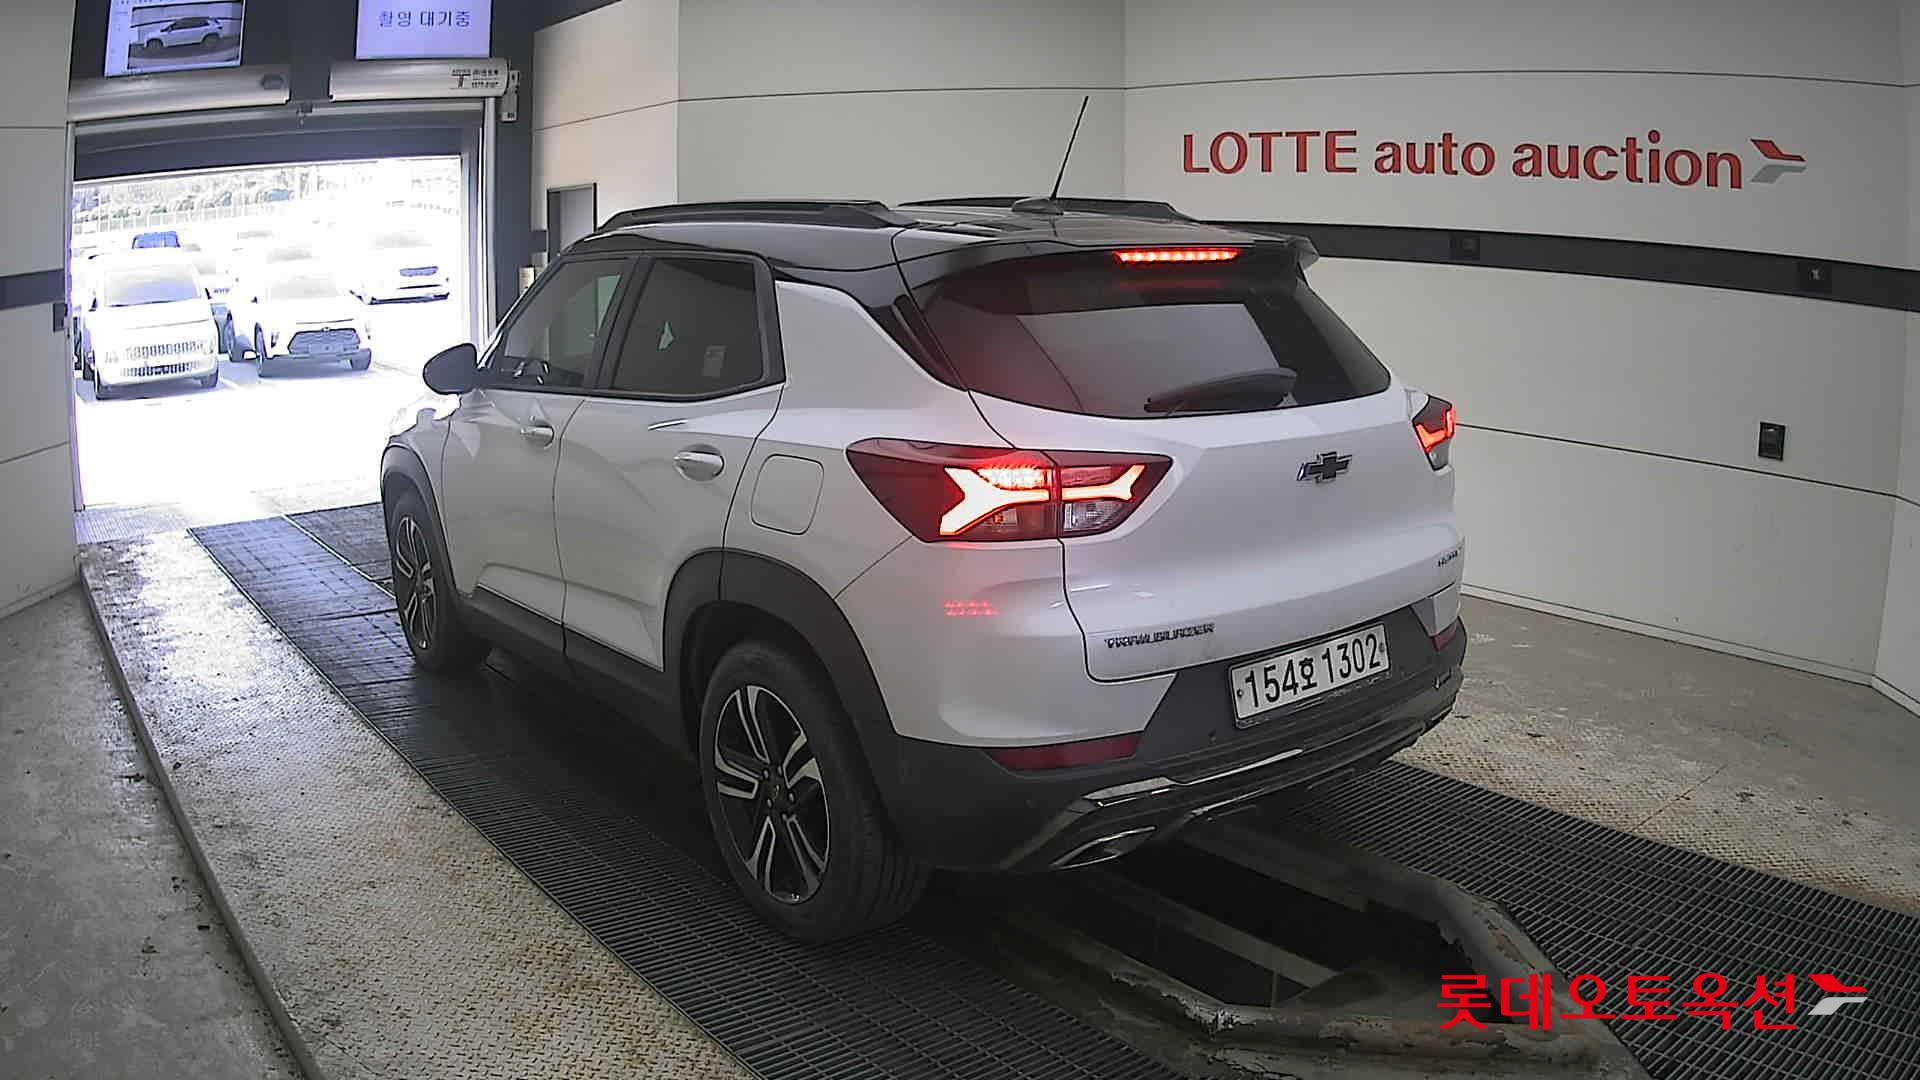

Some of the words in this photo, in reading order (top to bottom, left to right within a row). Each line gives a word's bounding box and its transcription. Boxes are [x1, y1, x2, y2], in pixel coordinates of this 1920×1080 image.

[420, 10, 470, 28] 대기중
[1183, 130, 1357, 174] LOTTE
[1374, 132, 1495, 176] auto
[1511, 129, 1742, 189] auction
[1245, 657, 1318, 708] 154호
[1322, 633, 1380, 684] 1302
